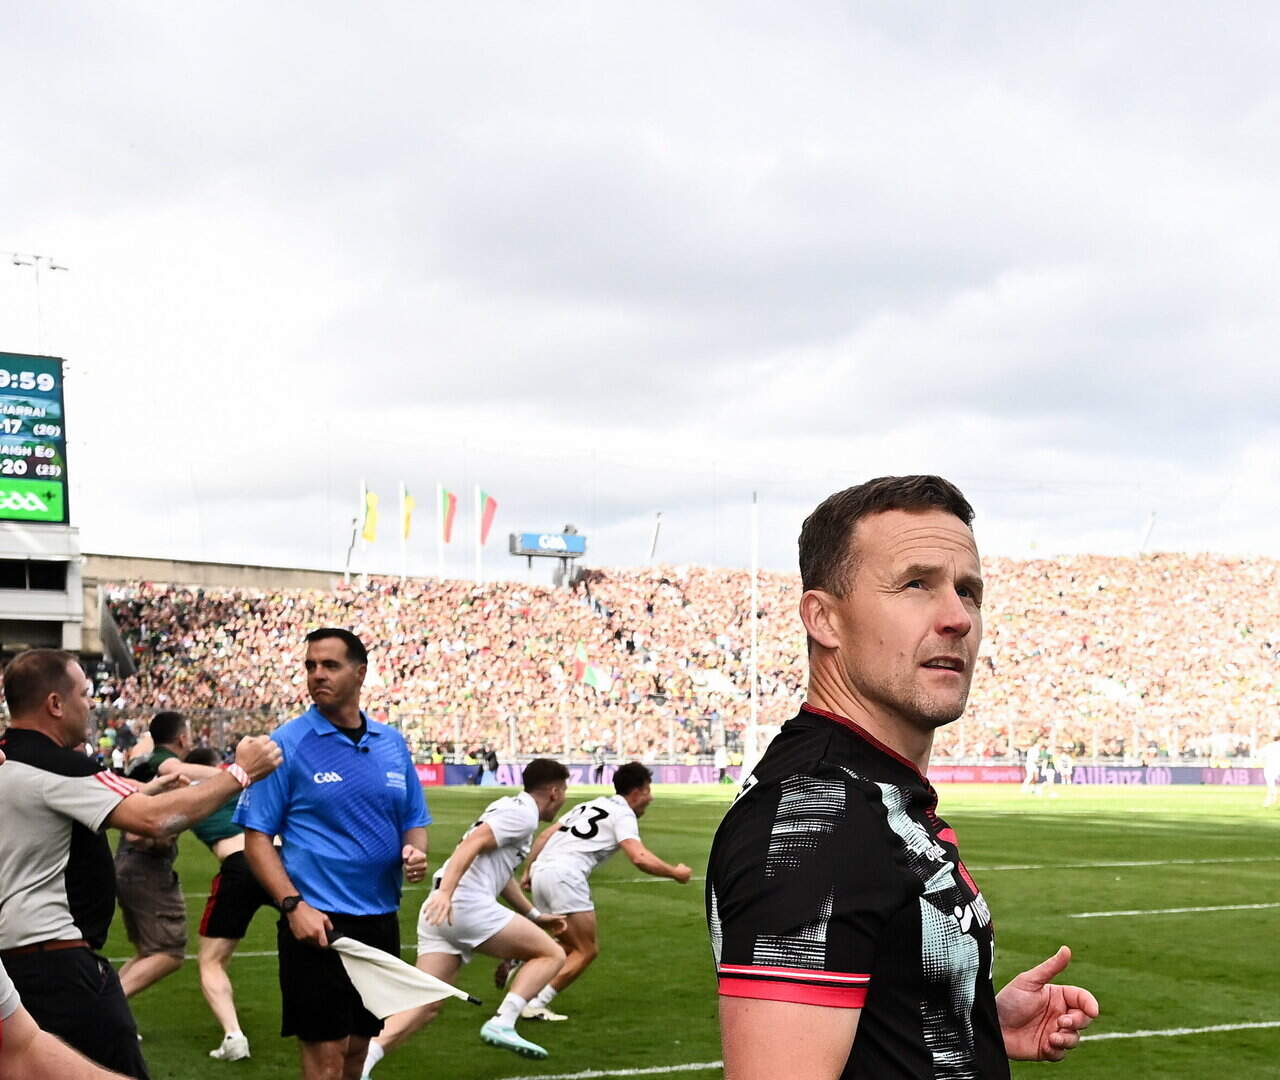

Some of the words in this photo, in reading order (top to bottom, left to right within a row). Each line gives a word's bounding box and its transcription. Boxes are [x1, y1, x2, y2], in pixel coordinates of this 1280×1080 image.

[314, 771, 343, 784] GAA
[1073, 766, 1142, 785] Allianz
[1222, 769, 1250, 785] AIB
